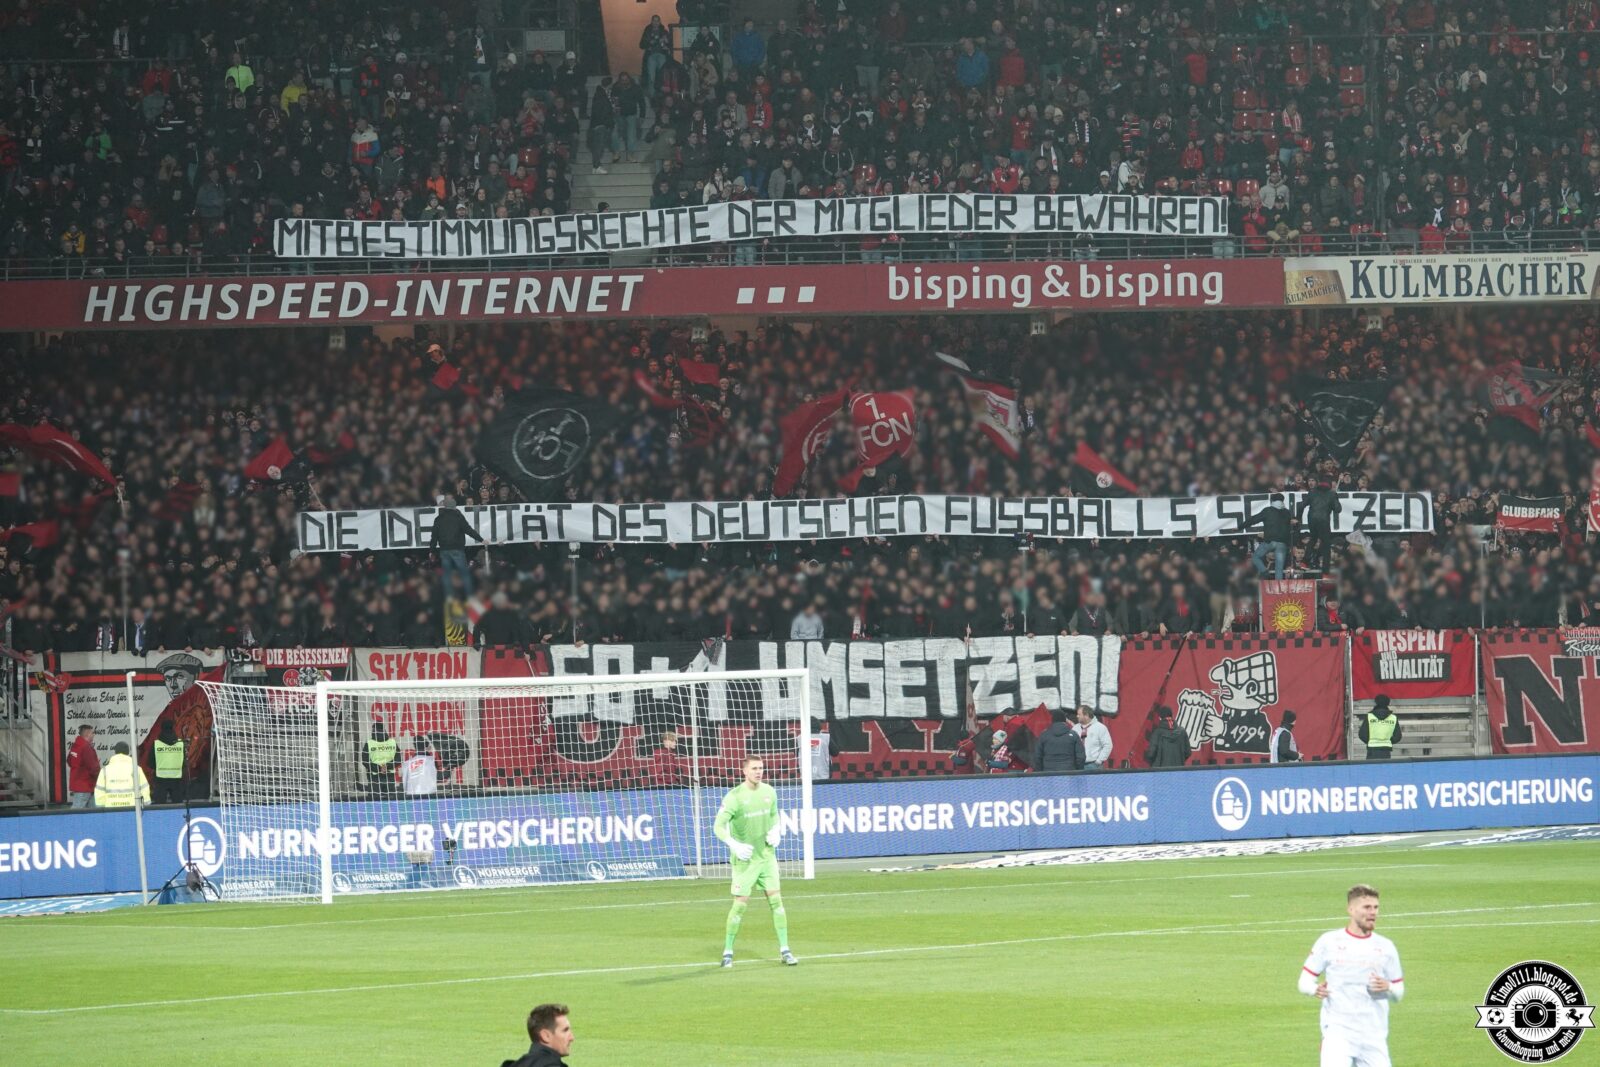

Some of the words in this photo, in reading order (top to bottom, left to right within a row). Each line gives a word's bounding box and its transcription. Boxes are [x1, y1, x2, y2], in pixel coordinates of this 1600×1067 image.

[278, 206, 711, 256] MITBESTIMMUNGSRECHTE
[728, 201, 797, 238] DER
[814, 196, 1018, 234] MITGLIEDER
[1034, 195, 1227, 234] BEWAHREN!
[889, 266, 1032, 307] bisping
[1041, 264, 1071, 298] &
[1080, 264, 1224, 306] bisping
[1285, 283, 1340, 304] KULMBACHER
[1350, 258, 1588, 299] KULMBACHER
[84, 274, 644, 322] HIGHSPEED-INTERNET
[864, 397, 886, 420] 1.
[858, 412, 913, 452] FCN
[301, 511, 358, 550] DIE
[381, 503, 572, 549] IDETITÄT
[592, 503, 668, 542] DES
[691, 495, 927, 541] DEUTSCHEN
[1217, 491, 1430, 535] SCTZEN
[1501, 505, 1560, 519] GLUBBFANS
[1376, 629, 1446, 652] RESPEKT
[266, 647, 284, 665] DIE
[286, 647, 349, 665] BESESSENEN
[368, 651, 468, 681] SEKTION
[1380, 654, 1444, 680] RIVALITÄT
[759, 634, 1122, 720] UMSETZEN!
[100, 691, 115, 702] Ehre
[117, 692, 127, 704] für
[106, 709, 126, 718] Verein
[371, 701, 465, 737] STADION
[67, 727, 76, 735] die
[1231, 725, 1266, 743] 1994
[961, 794, 1149, 829] VERSICHERUNG
[1260, 784, 1418, 816] NÜRNBERGER
[1424, 777, 1593, 809] VERSICHERUNG
[239, 824, 434, 859] NÜRNBERGER
[442, 814, 653, 849] VERSICHERUNG
[478, 866, 540, 878] NÜRNBERGER
